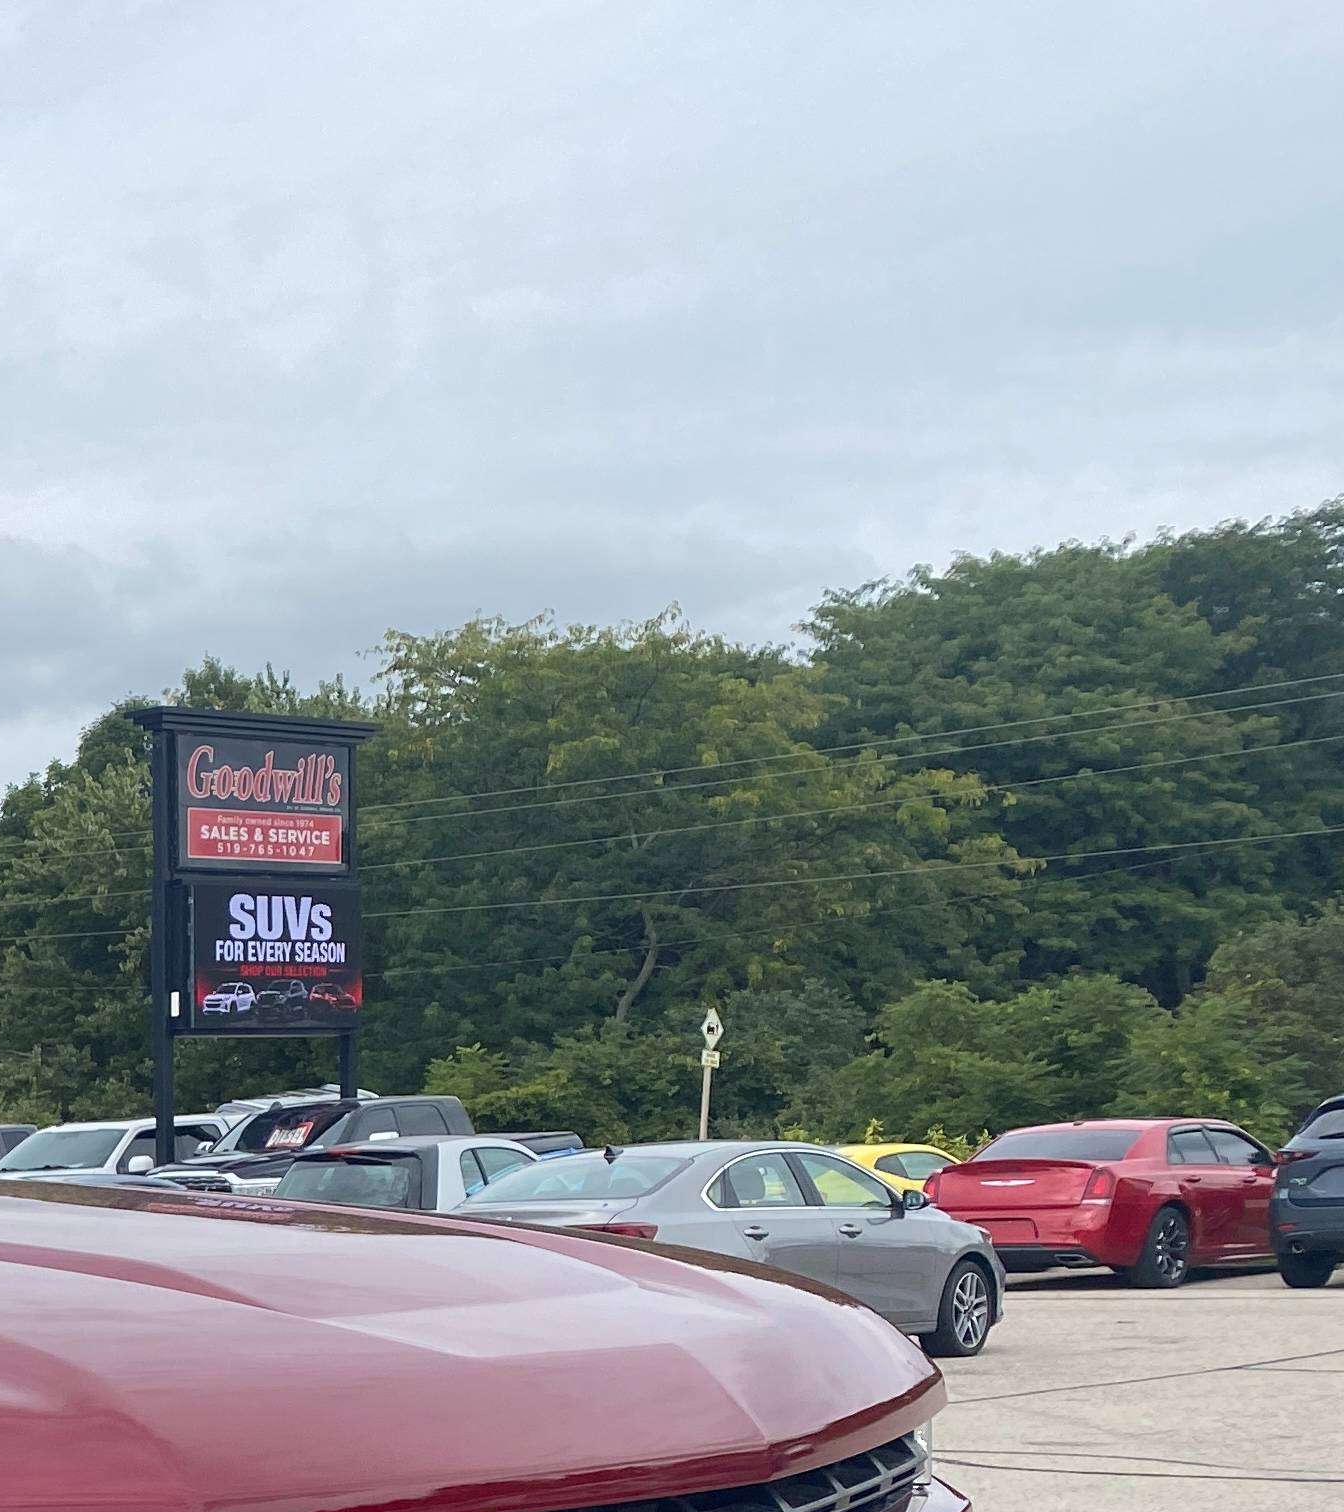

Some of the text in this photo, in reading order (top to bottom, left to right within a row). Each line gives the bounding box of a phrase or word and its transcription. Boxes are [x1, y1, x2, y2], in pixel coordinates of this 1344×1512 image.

[187, 745, 342, 806] Goodwill's
[217, 815, 243, 826] Family
[200, 825, 330, 845] SALES & SERVICE
[217, 842, 314, 856] 519-765-1047
[229, 893, 333, 941] SUVs
[215, 940, 346, 963] FOR EVERY SEASON
[265, 1126, 308, 1148] DIESEL
